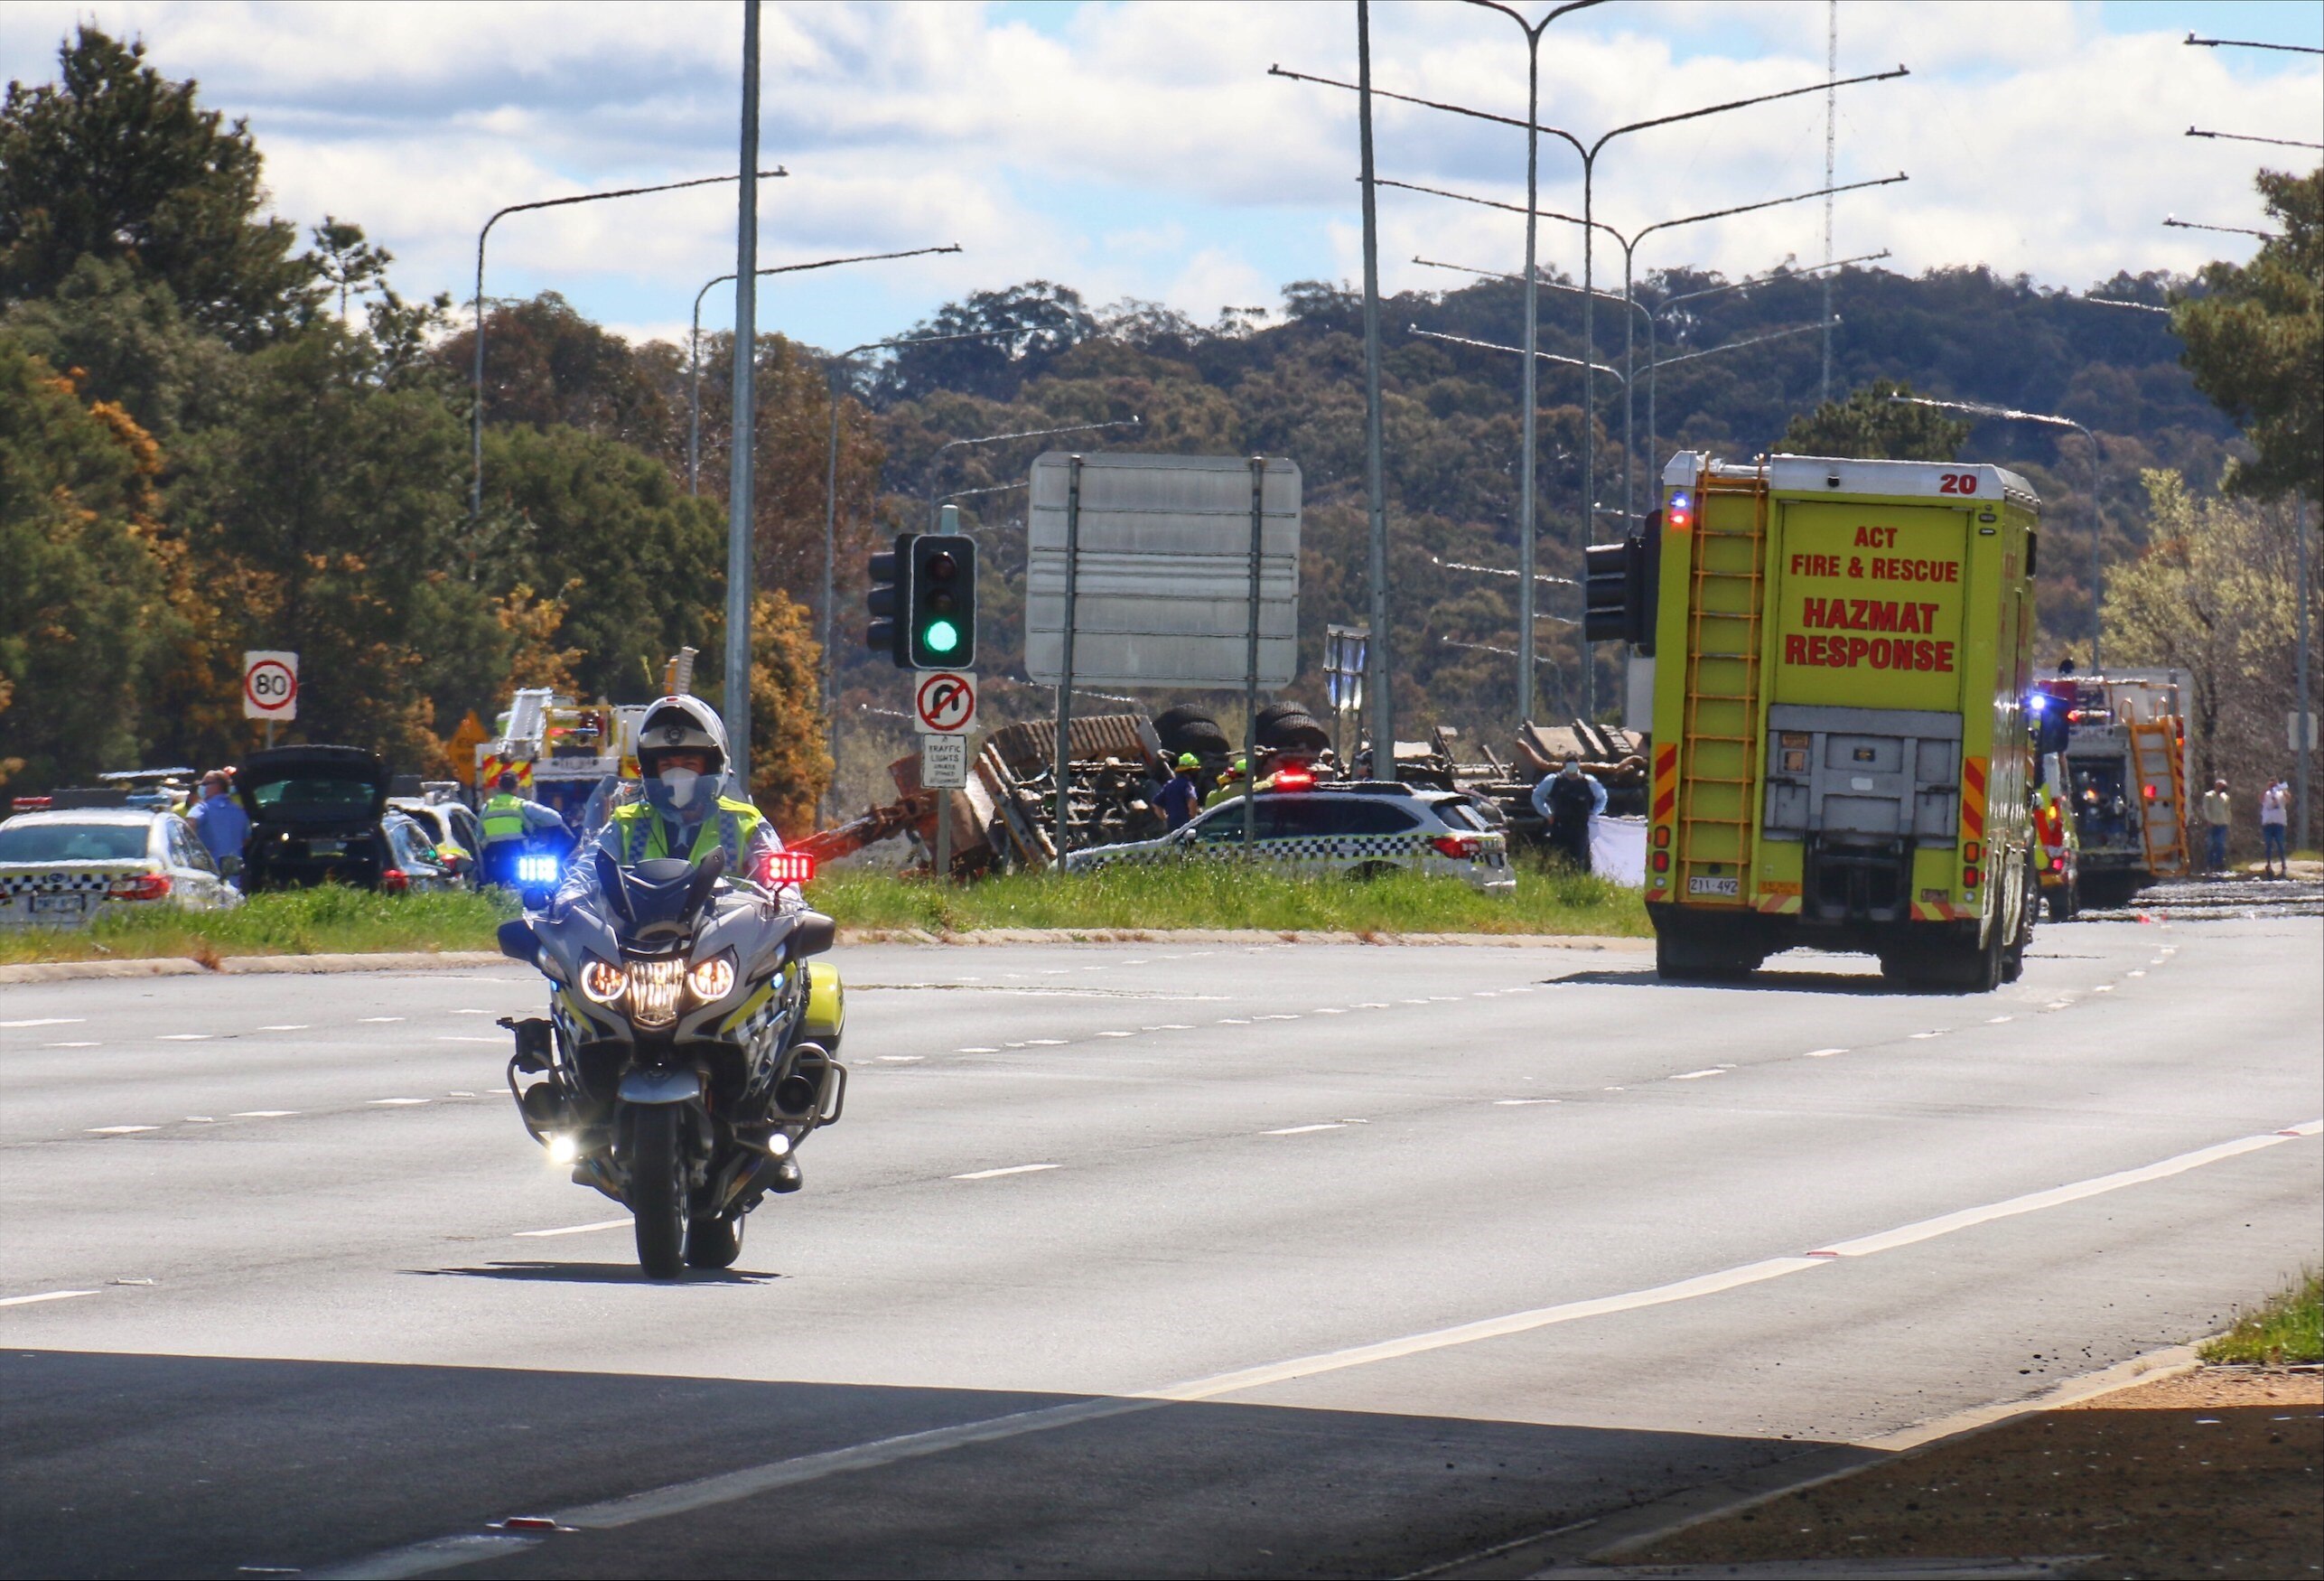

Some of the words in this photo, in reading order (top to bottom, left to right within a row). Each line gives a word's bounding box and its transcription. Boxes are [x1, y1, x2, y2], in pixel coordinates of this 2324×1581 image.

[1939, 473, 1977, 495] 20
[1853, 526, 1898, 548] ACT
[1790, 554, 1841, 577] FIRE
[1847, 557, 1863, 578] &
[1871, 557, 1959, 583] RESCUE
[1803, 597, 1939, 634] HAZMAT
[1785, 634, 1955, 672] RESPONSE
[257, 674, 286, 696] 80
[929, 744, 961, 753] TRAFFIC
[930, 753, 959, 762] LIGHTS
